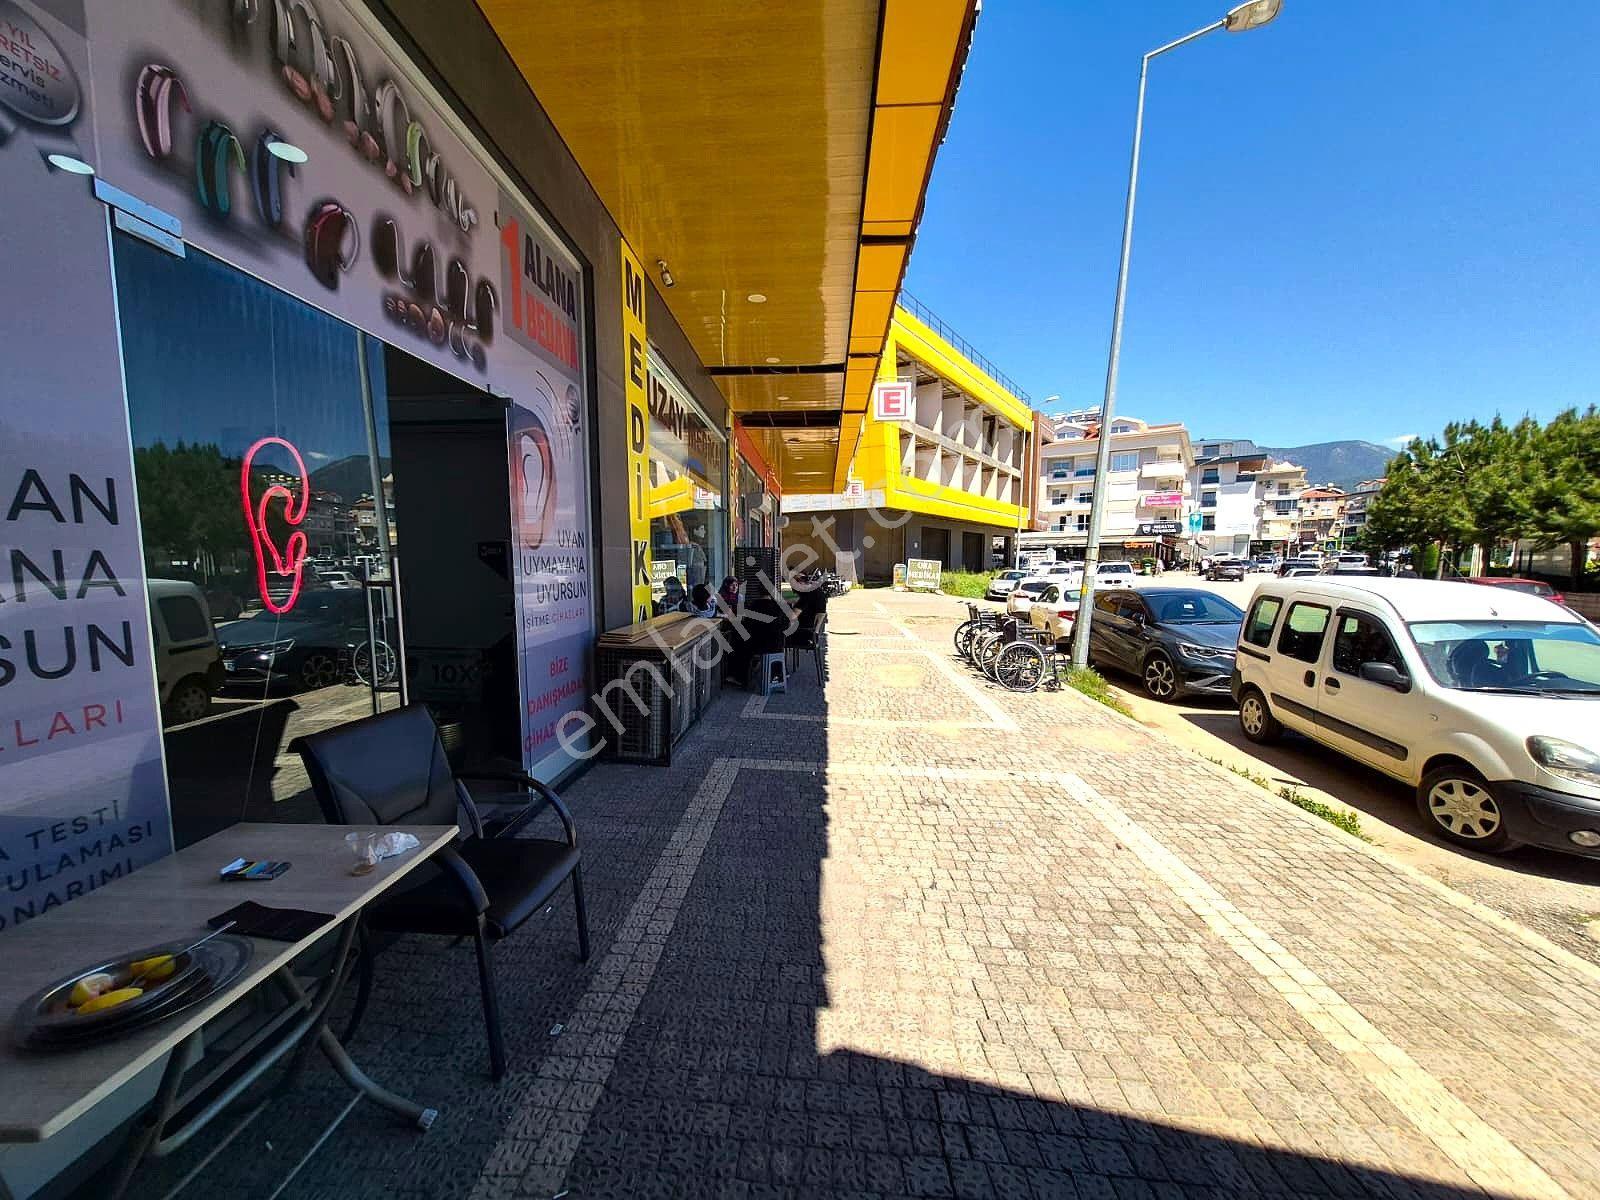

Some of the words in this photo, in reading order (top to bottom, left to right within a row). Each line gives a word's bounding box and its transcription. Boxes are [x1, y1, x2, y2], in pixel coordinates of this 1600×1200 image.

[501, 216, 523, 329] 1
[524, 233, 577, 322] ALANA
[884, 392, 900, 413] E
[6, 469, 119, 525] AN
[852, 485, 860, 494] E
[558, 528, 585, 548] UYAN
[0, 549, 127, 603] NA
[536, 581, 587, 604] UYURSUN
[0, 620, 134, 687] SUN
[0, 699, 123, 752] LARI
[7, 820, 153, 892] ULAMASI
